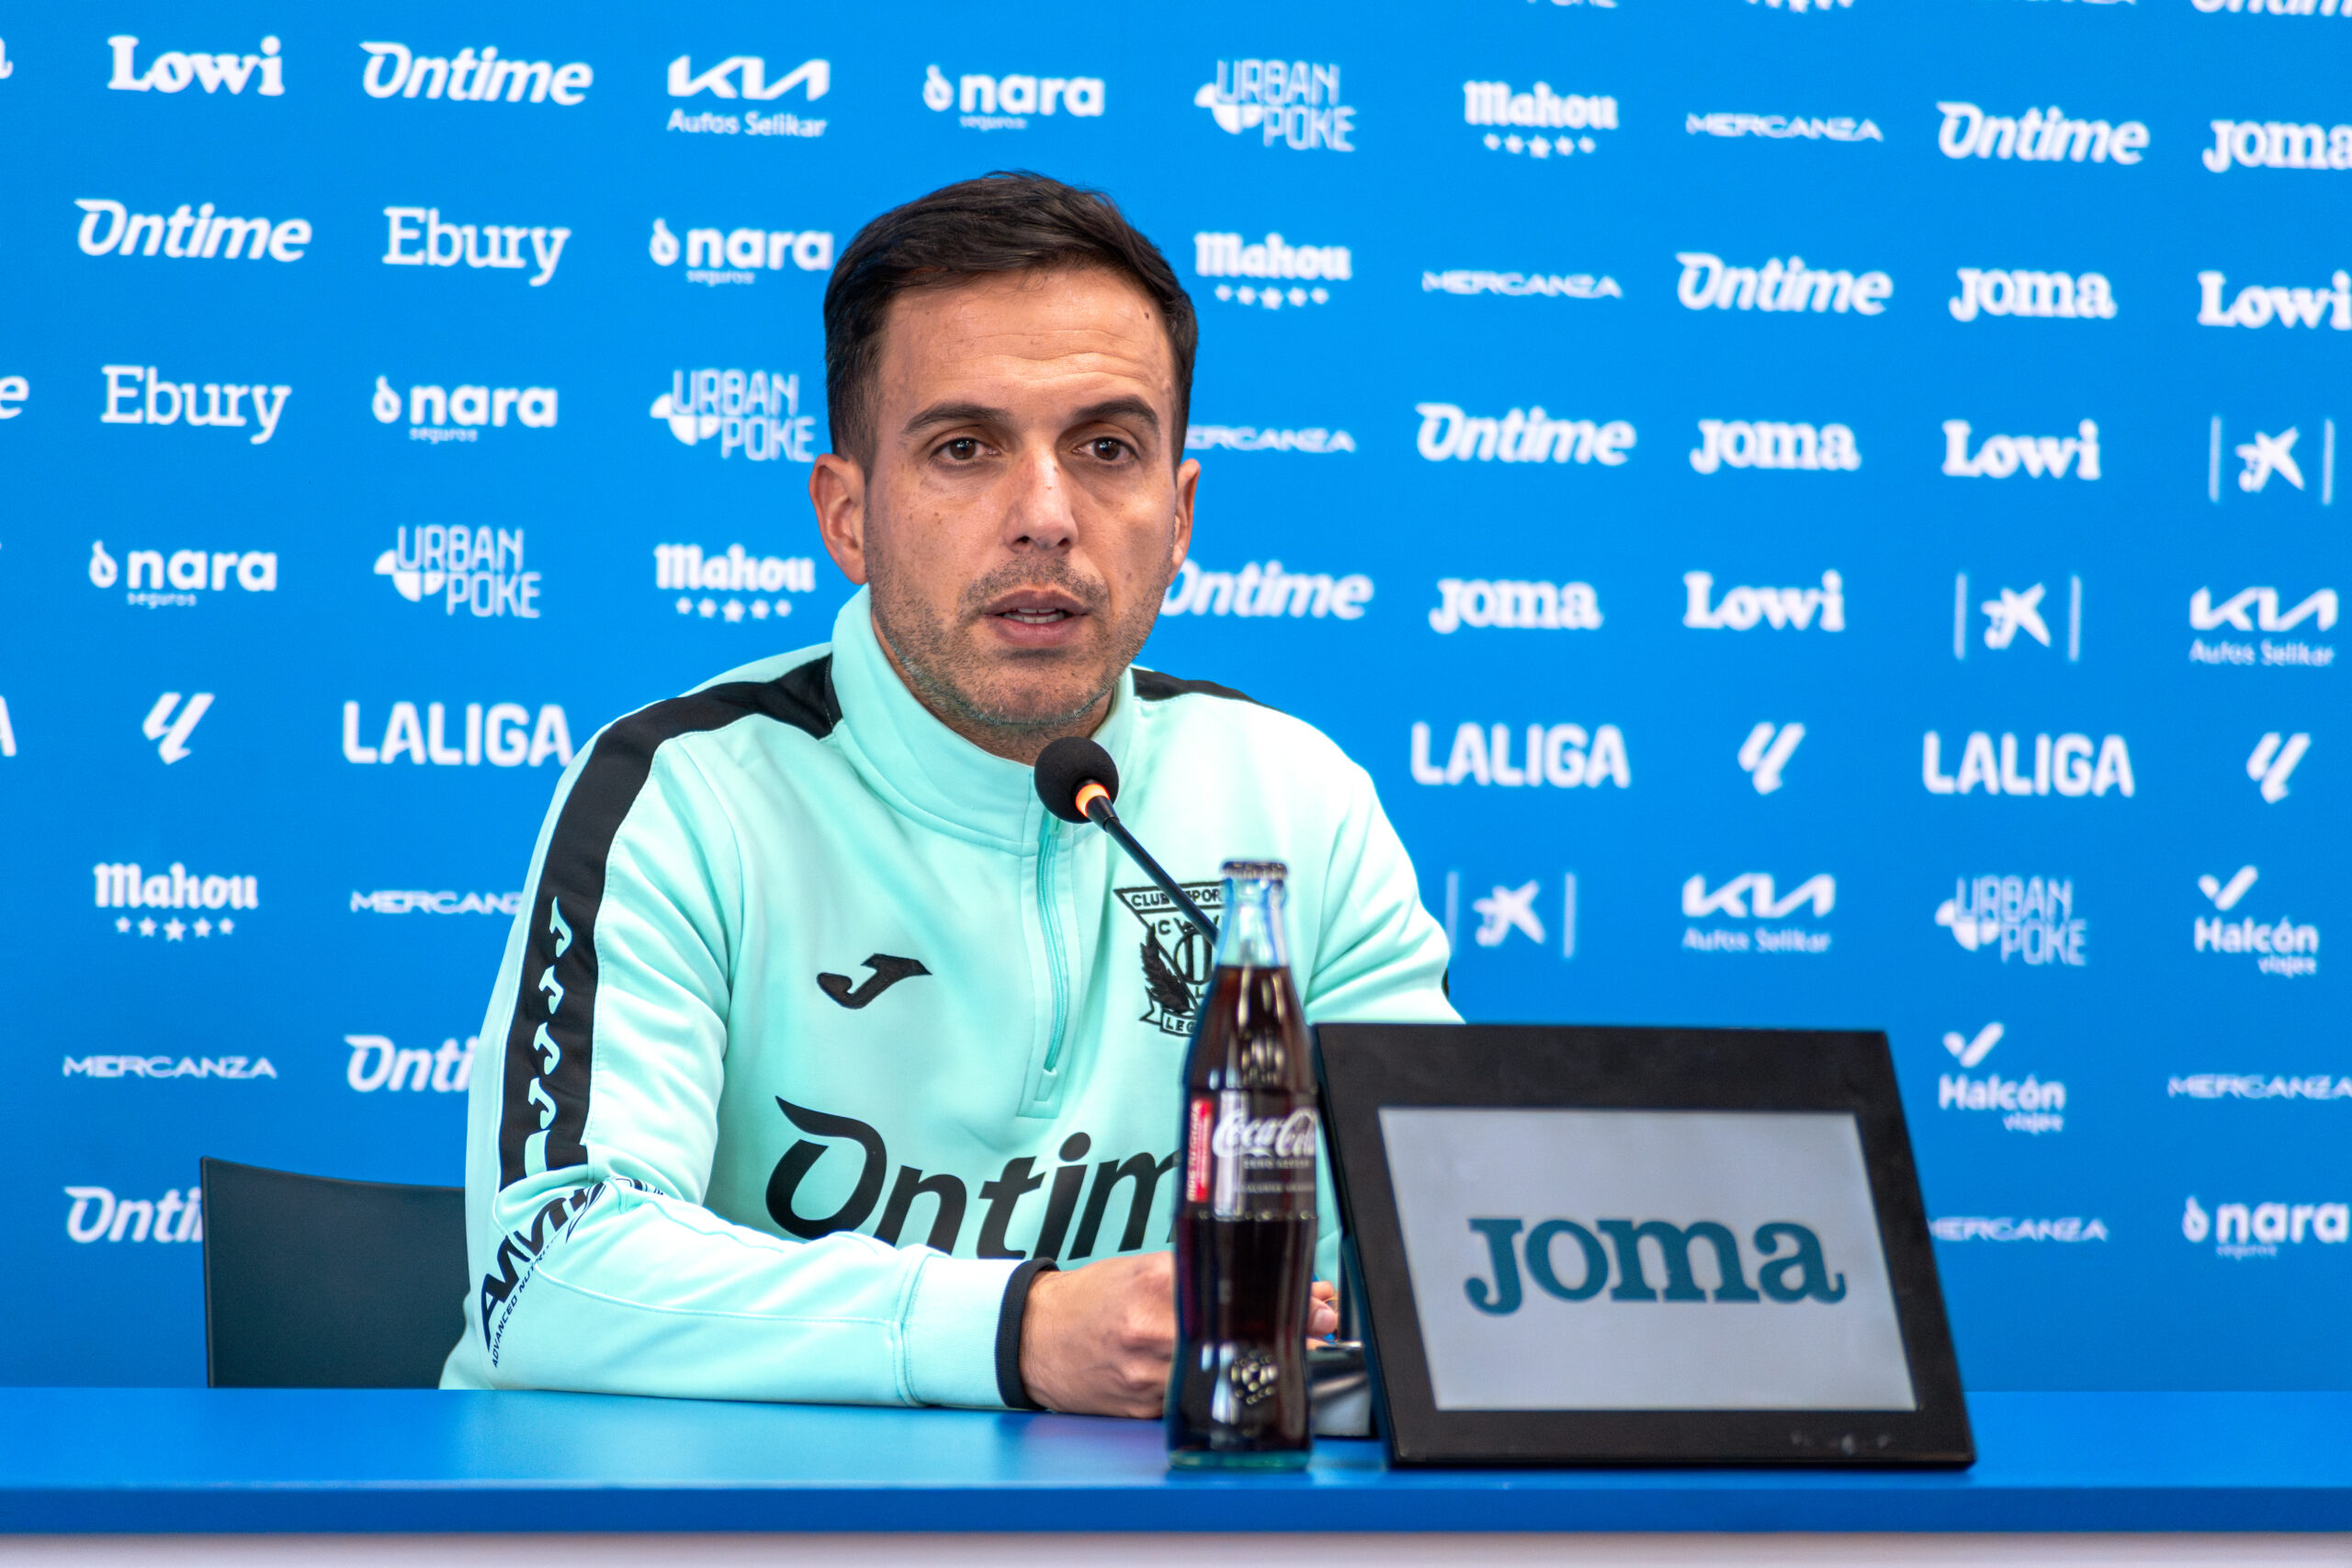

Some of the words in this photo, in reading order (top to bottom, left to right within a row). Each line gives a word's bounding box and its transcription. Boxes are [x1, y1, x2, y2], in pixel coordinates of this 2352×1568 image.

[108, 36, 284, 96] Lowi
[359, 41, 594, 106] Ontime
[1216, 58, 1340, 106] URBAN
[960, 73, 1105, 118] nara
[1464, 80, 1619, 130] Mahou
[666, 108, 741, 135] Autos
[1262, 106, 1357, 152] POKE
[1685, 113, 1883, 141] MERCANZA
[1936, 101, 2150, 164] Ontime
[74, 198, 312, 263] Ontime
[381, 206, 571, 287] Ebury
[686, 227, 834, 271] nara
[1193, 231, 1352, 281] Mahou
[1421, 270, 1623, 299] MERCANZA
[1676, 252, 1894, 316] Ontime
[1948, 267, 2118, 322] Joma
[2197, 270, 2352, 331] Lowi
[100, 365, 292, 445] Ebury
[410, 384, 559, 429] nara
[673, 368, 799, 415] URBAN
[720, 415, 816, 463] POKE
[1185, 424, 1356, 454] ERCANZA
[1415, 402, 1637, 467] Ontime
[1689, 419, 1861, 475] Joma
[1941, 418, 2101, 480] Lowi
[128, 549, 277, 592] nara
[397, 524, 524, 572] URBAN
[653, 543, 816, 592] Mahou
[447, 570, 542, 619] POKE
[1428, 578, 1604, 635] Joma
[1682, 570, 1845, 632] Lowi
[342, 700, 574, 768] LALIGA
[1410, 721, 1631, 789] LALIGA
[1922, 730, 2135, 797] LALIGA
[93, 862, 259, 910] Mahou
[349, 890, 523, 915] MERCANZ
[1955, 875, 2074, 923] URBAN
[2000, 919, 2087, 966] POKE
[62, 1055, 277, 1079] MERCANZA
[345, 1034, 479, 1093] Onti
[765, 1095, 1180, 1259] Ontim
[64, 1186, 203, 1244] Onti
[1927, 1216, 2109, 1242] ERCANZA
[2215, 1201, 2350, 1244] nara
[1464, 1218, 1848, 1317] Joma
[492, 1297, 518, 1369] ADVANCED
